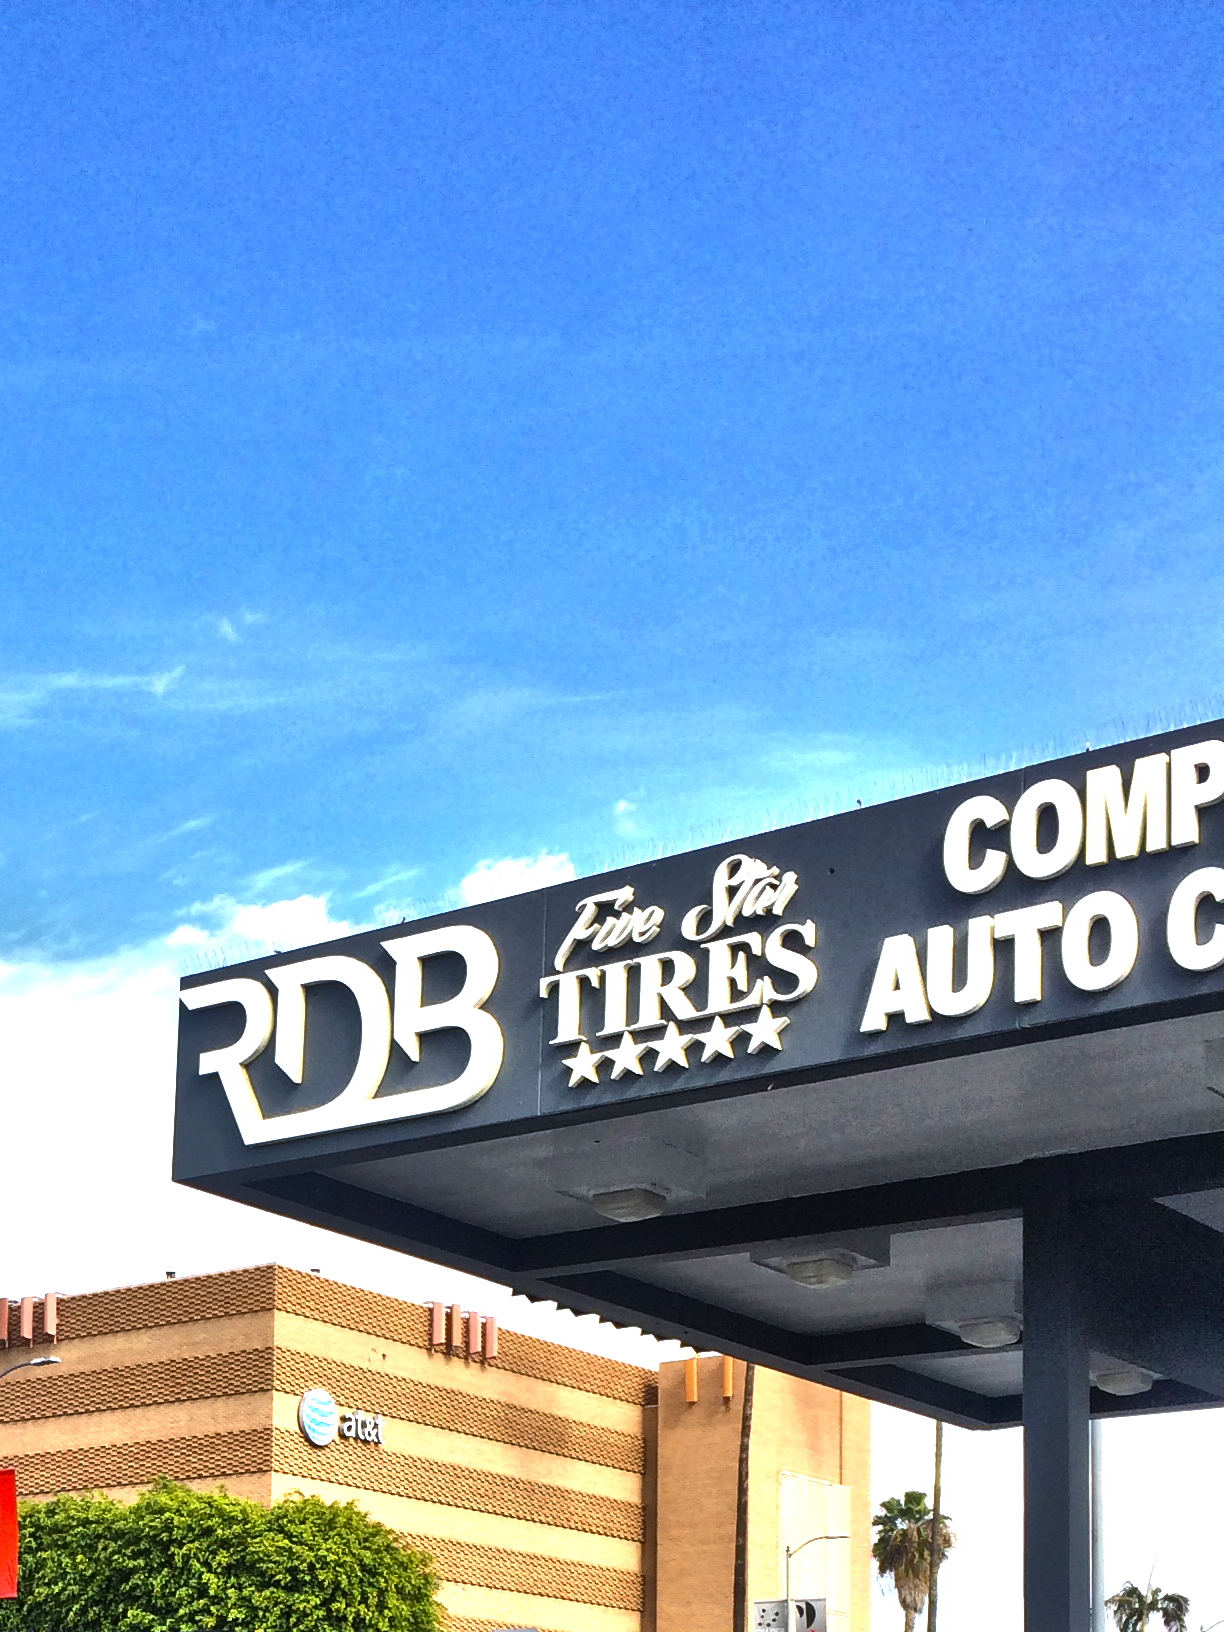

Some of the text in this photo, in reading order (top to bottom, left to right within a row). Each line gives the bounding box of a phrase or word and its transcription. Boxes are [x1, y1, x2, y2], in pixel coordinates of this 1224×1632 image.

[943, 739, 1224, 895] COMP
[554, 854, 799, 972] Five Star
[859, 890, 1139, 1033] AUTO
[179, 924, 505, 1146] RDB
[539, 918, 819, 1046] TIRES
[341, 1409, 386, 1445] at&t
